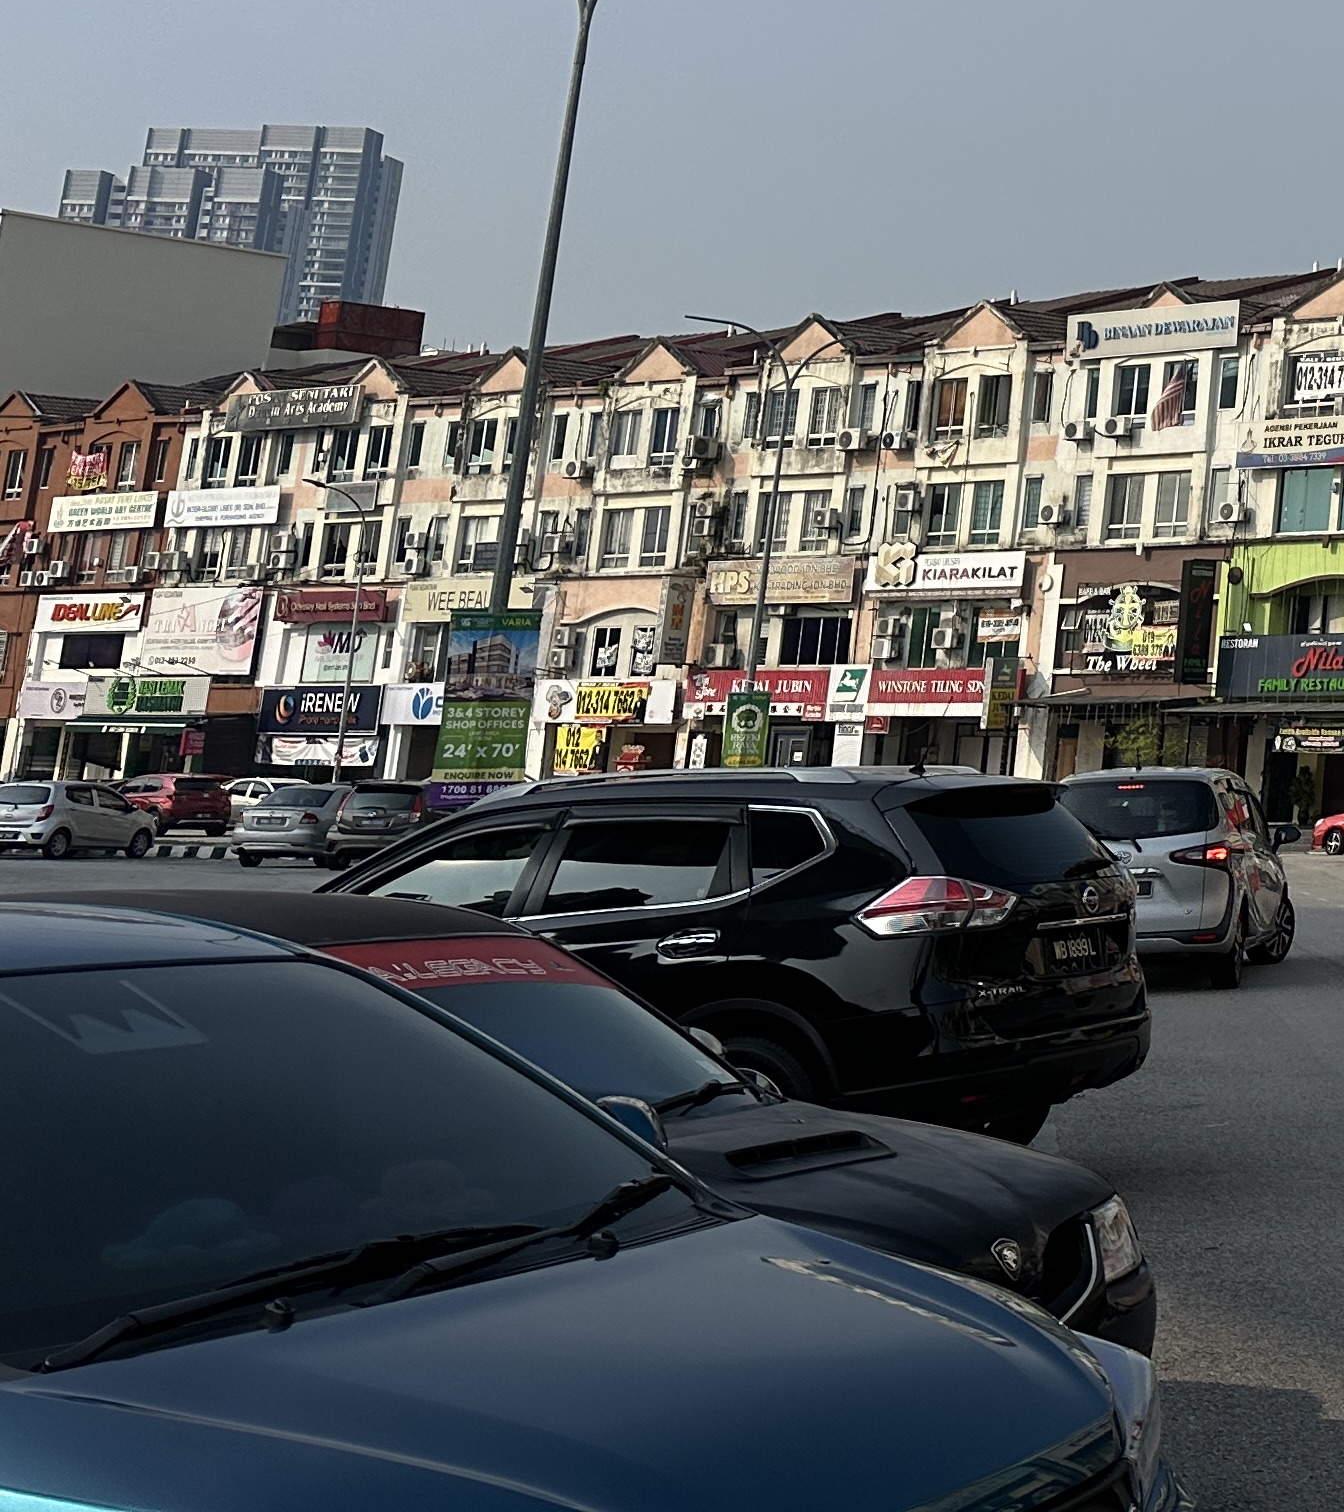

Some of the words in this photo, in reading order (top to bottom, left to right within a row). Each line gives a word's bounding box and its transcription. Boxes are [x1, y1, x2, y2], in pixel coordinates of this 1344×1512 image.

[1154, 315, 1235, 336] DEWARAJAN
[1296, 365, 1335, 392] 012-314
[323, 386, 354, 400] TARI
[307, 399, 350, 416] Academy
[1263, 435, 1304, 450] IKRAR
[921, 566, 1018, 582] KIARAKILAT
[427, 591, 456, 612] WEE
[502, 617, 532, 628] VARIA
[1221, 638, 1259, 649] RESTORAN
[1086, 656, 1113, 673] The
[775, 679, 812, 694] JUBIN
[877, 679, 928, 694] WINSTONE
[930, 679, 964, 694] TILING
[1257, 677, 1299, 693] FAMILY
[577, 689, 610, 714] 012-314
[611, 689, 636, 713] 7662
[446, 707, 474, 718] 3&4
[475, 707, 527, 718] STOREY
[445, 719, 476, 730] SHOP
[477, 719, 525, 730] OFFICES
[565, 726, 581, 748] 012
[568, 748, 590, 770] 7662
[443, 771, 488, 781] ENQUIRE
[488, 771, 515, 780] NOW
[441, 785, 467, 794] 1700
[978, 985, 1027, 997] X-TRAIL
